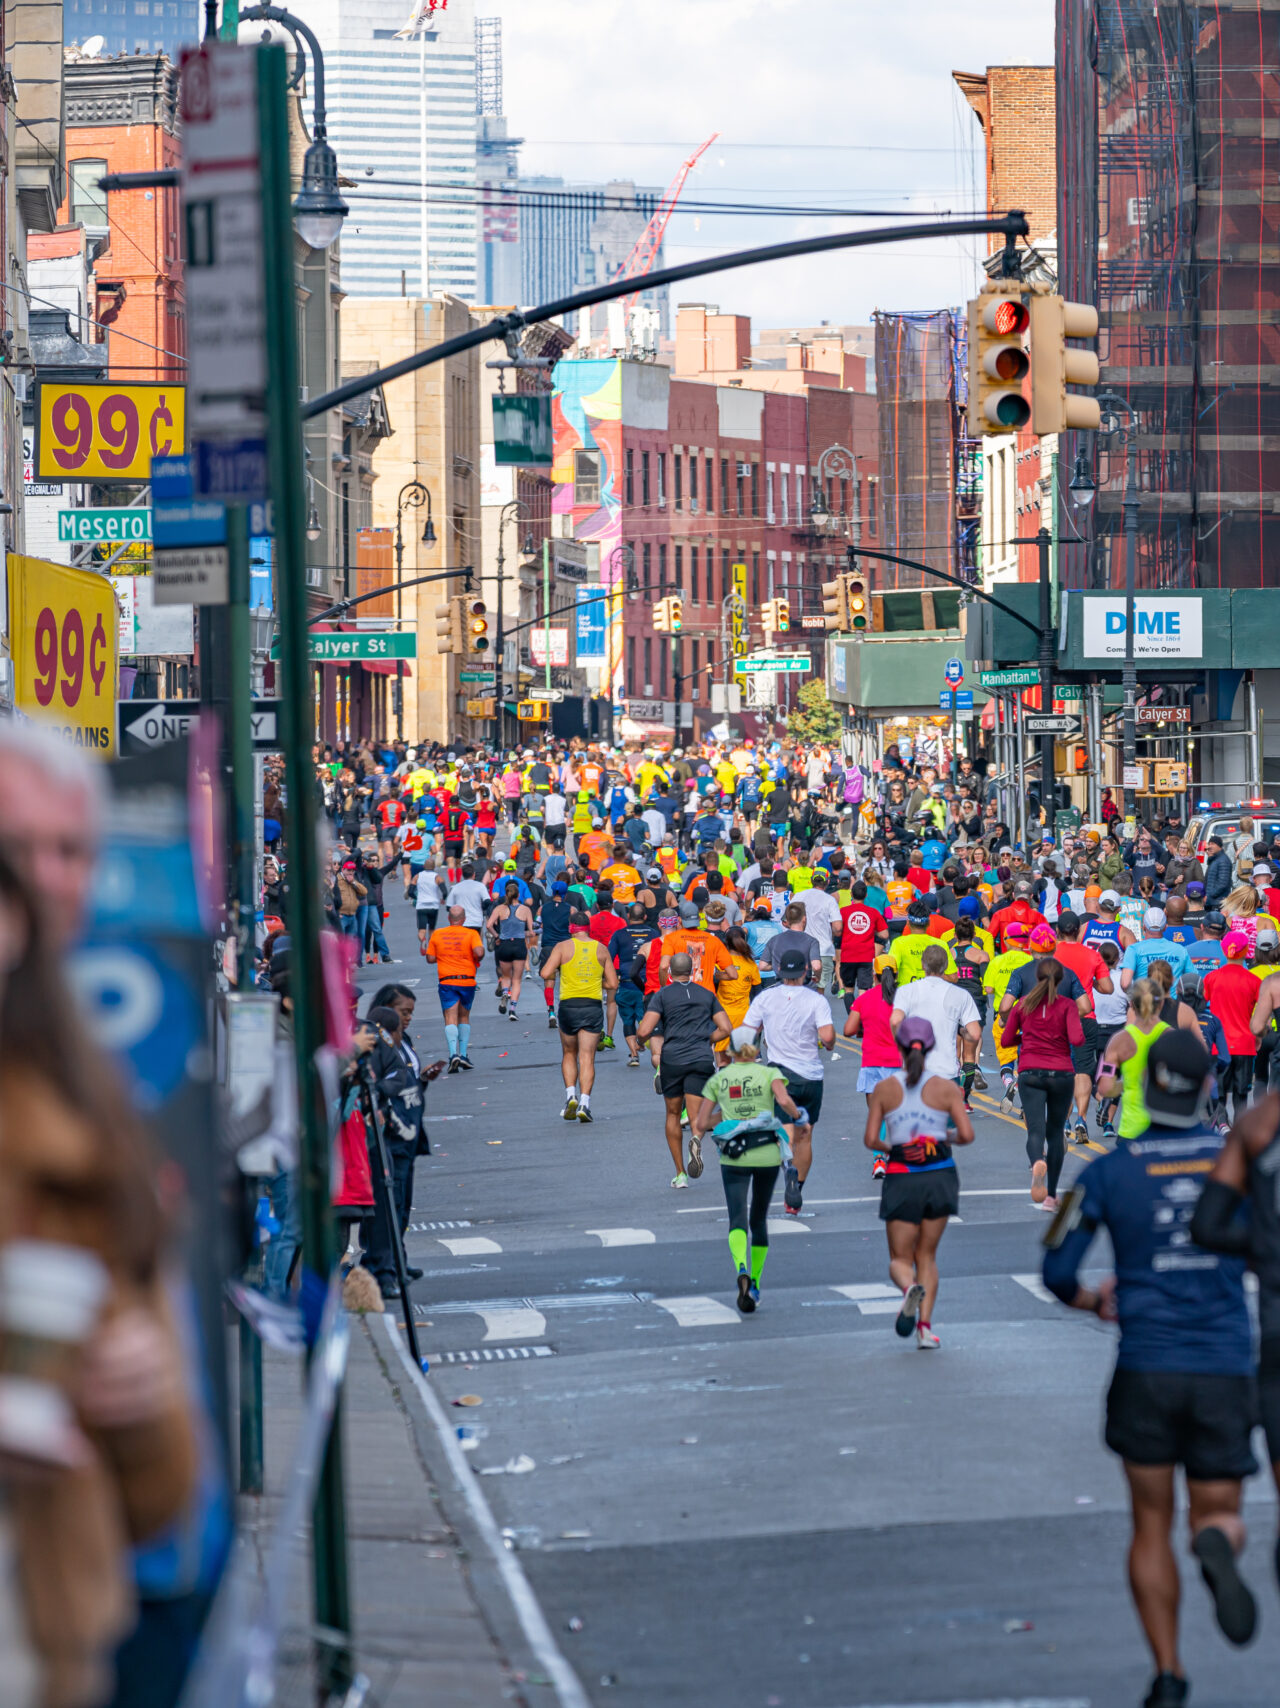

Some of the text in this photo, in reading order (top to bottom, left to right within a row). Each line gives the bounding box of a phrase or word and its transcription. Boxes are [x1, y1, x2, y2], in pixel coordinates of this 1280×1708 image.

[60, 514, 152, 540] Meserol
[802, 617, 825, 628] Noble
[734, 567, 747, 693] LIQUOS
[367, 638, 387, 653] St
[1161, 646, 1181, 654] Open
[745, 661, 802, 671] Greenpoint Av
[982, 672, 1030, 685] Manhattan
[1058, 686, 1082, 700] Caly
[1139, 709, 1187, 721] Calyer St
[144, 718, 190, 740] ONE
[1032, 720, 1075, 728] ONE WAY
[1120, 902, 1142, 914] ABU
[1090, 928, 1114, 937] MATT
